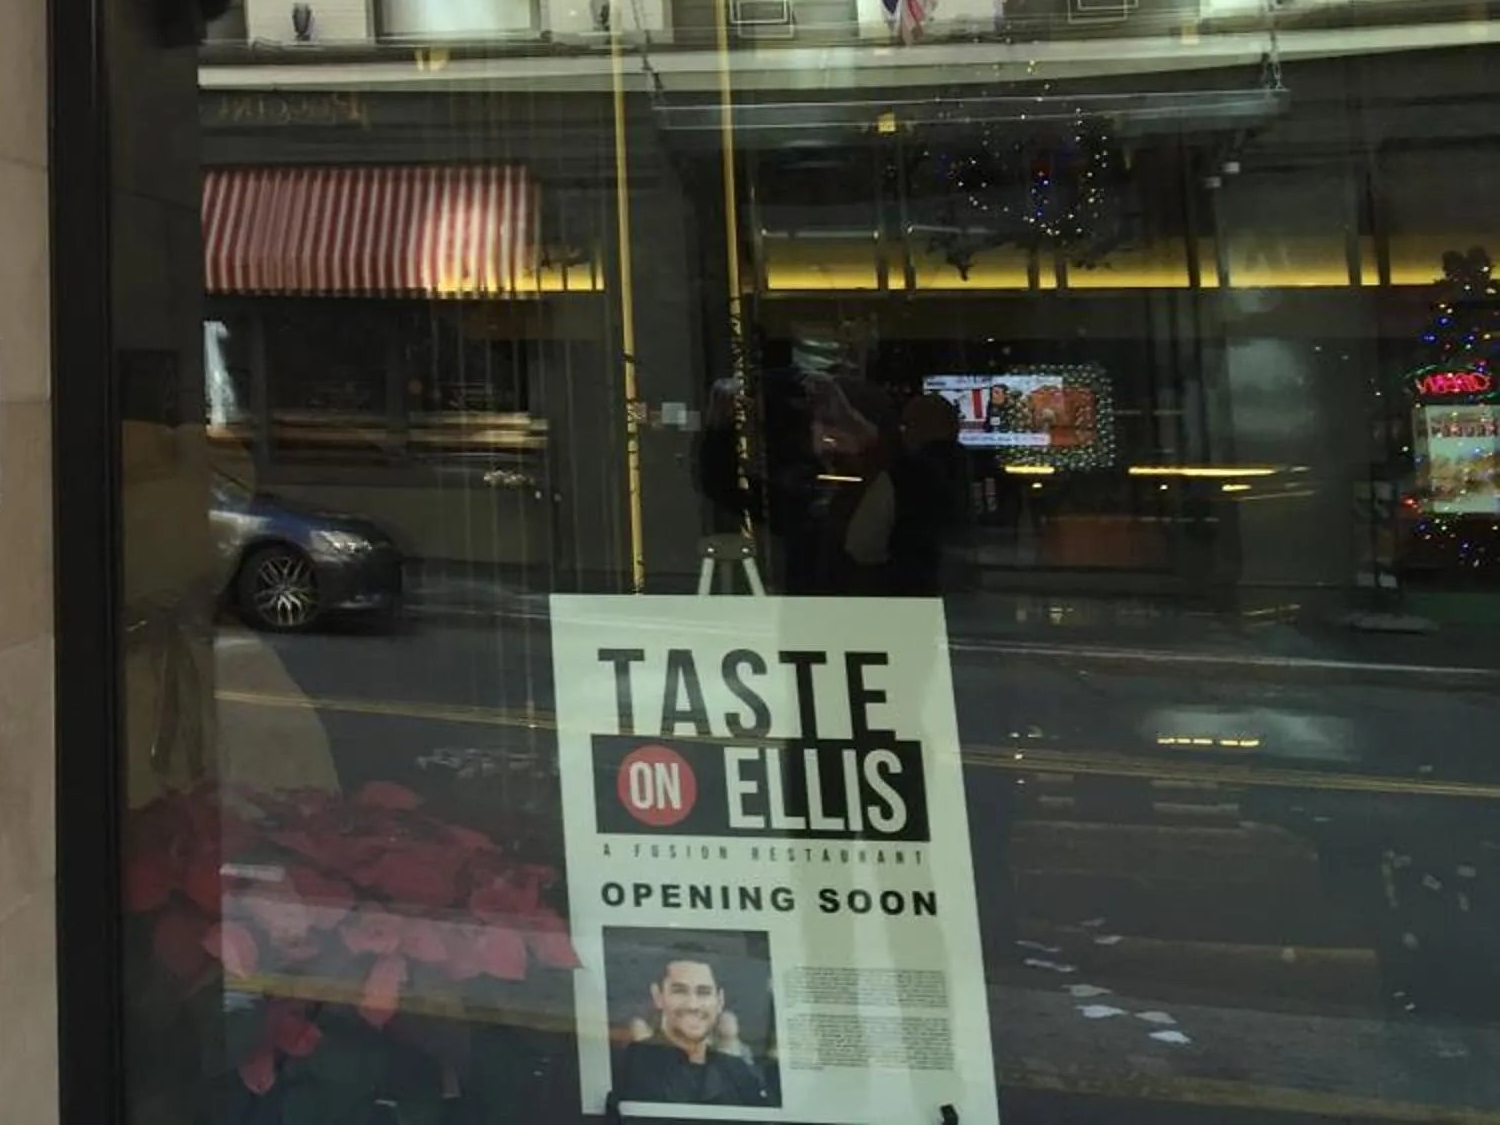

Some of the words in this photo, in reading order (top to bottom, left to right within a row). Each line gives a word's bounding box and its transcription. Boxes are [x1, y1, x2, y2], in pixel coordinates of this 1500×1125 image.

[597, 648, 897, 741] TASTE
[628, 761, 682, 811] ON
[723, 746, 908, 834] ELLIS
[603, 843, 612, 858] A
[633, 844, 728, 861] FUSION
[751, 845, 925, 866] RESTAURANT
[601, 881, 796, 913] OPENING
[819, 888, 938, 917] SOON
